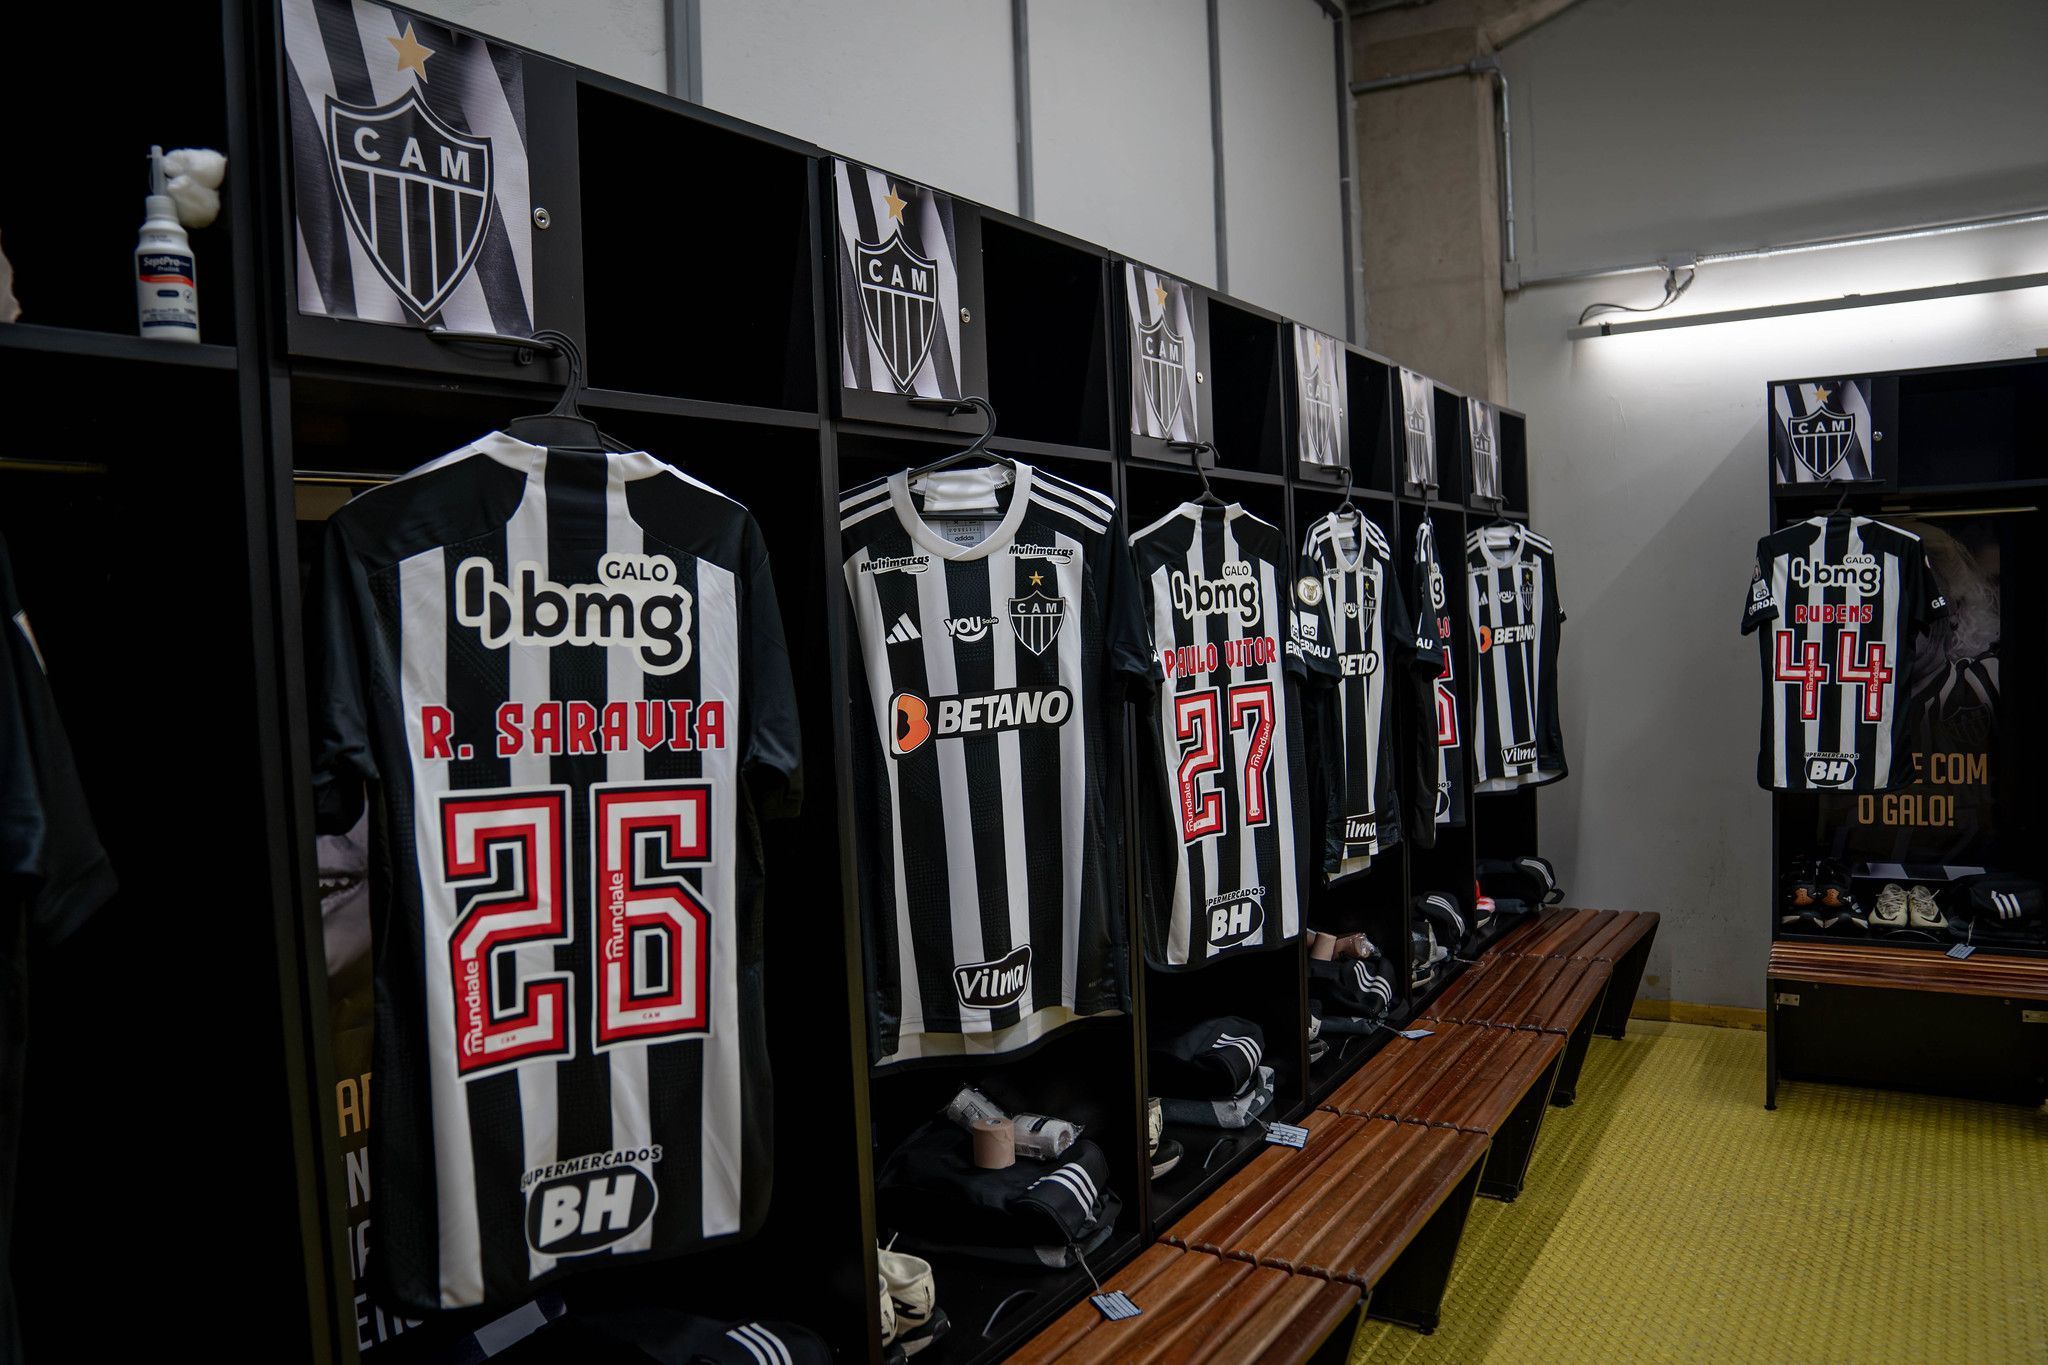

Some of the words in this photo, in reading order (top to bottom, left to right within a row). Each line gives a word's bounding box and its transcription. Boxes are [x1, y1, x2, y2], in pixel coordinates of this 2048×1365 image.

[353, 126, 471, 183] CAM
[868, 258, 928, 293] CAM
[1145, 336, 1180, 362] CAM
[1797, 420, 1846, 434] CAM
[860, 555, 930, 573] Multimarcas
[1008, 545, 1075, 556] Multimarcas
[1845, 556, 1872, 564] GALO
[605, 560, 669, 581] GALO
[1224, 565, 1249, 576] GALO
[1814, 561, 1878, 594] bmg
[1017, 603, 1057, 613] CAM
[1195, 574, 1257, 623] bmg
[1795, 604, 1873, 624] RUBENS
[522, 570, 686, 667] bmg
[944, 616, 981, 636] YOU
[1163, 643, 1218, 679] PAULO
[1774, 630, 1893, 721] 44
[937, 689, 1070, 735] BETANO
[420, 704, 474, 760] R.
[498, 700, 727, 758] SARAVIA
[1174, 682, 1276, 844] 27
[1810, 760, 1849, 781] BH
[1930, 752, 1988, 785] COM
[1858, 794, 1875, 825] O
[1882, 794, 1955, 827] GALO!
[1345, 819, 1377, 839] ilma
[438, 783, 713, 1075] 26
[605, 872, 624, 960] mundiale
[1210, 901, 1252, 942] BH
[959, 963, 1024, 999] Vilma
[463, 960, 483, 1056] mundiale
[538, 1173, 637, 1248] BH
